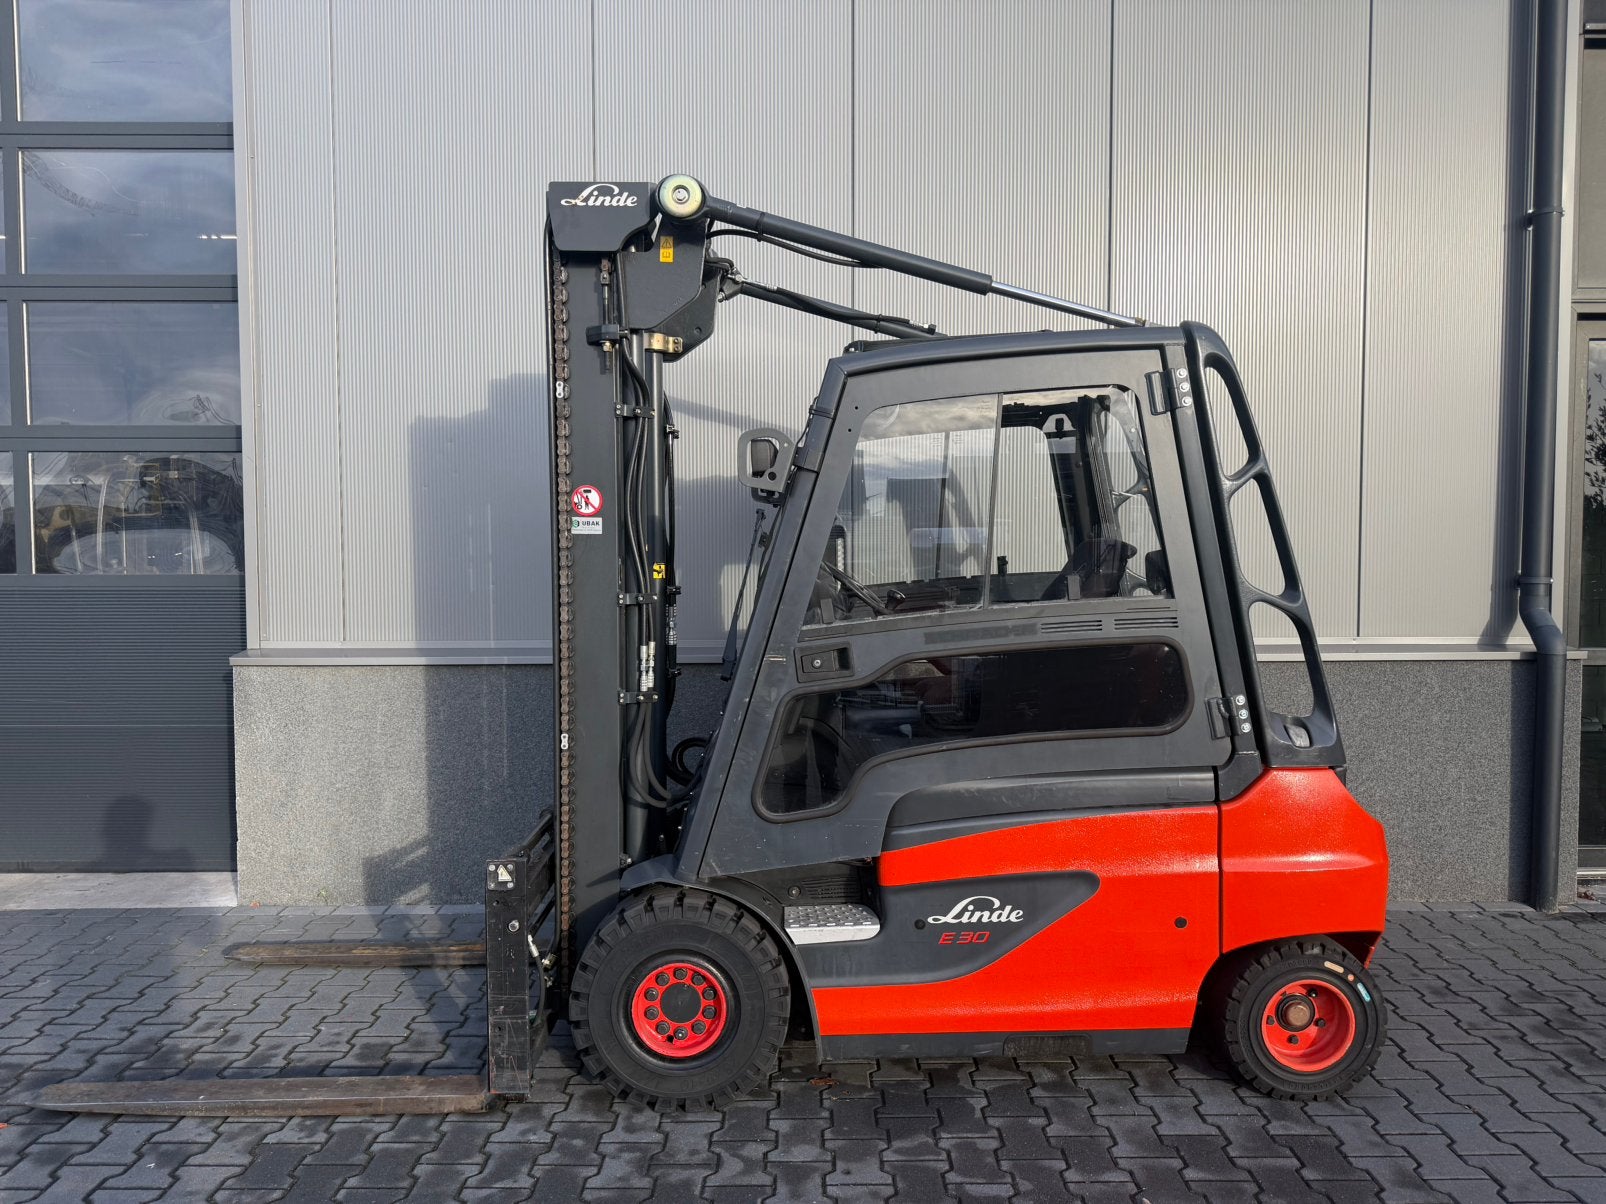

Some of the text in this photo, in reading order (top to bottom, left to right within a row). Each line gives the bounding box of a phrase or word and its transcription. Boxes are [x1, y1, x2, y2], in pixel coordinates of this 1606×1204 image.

[560, 183, 638, 207] Linde
[927, 895, 1024, 924] Linde
[938, 931, 991, 945] E 30
